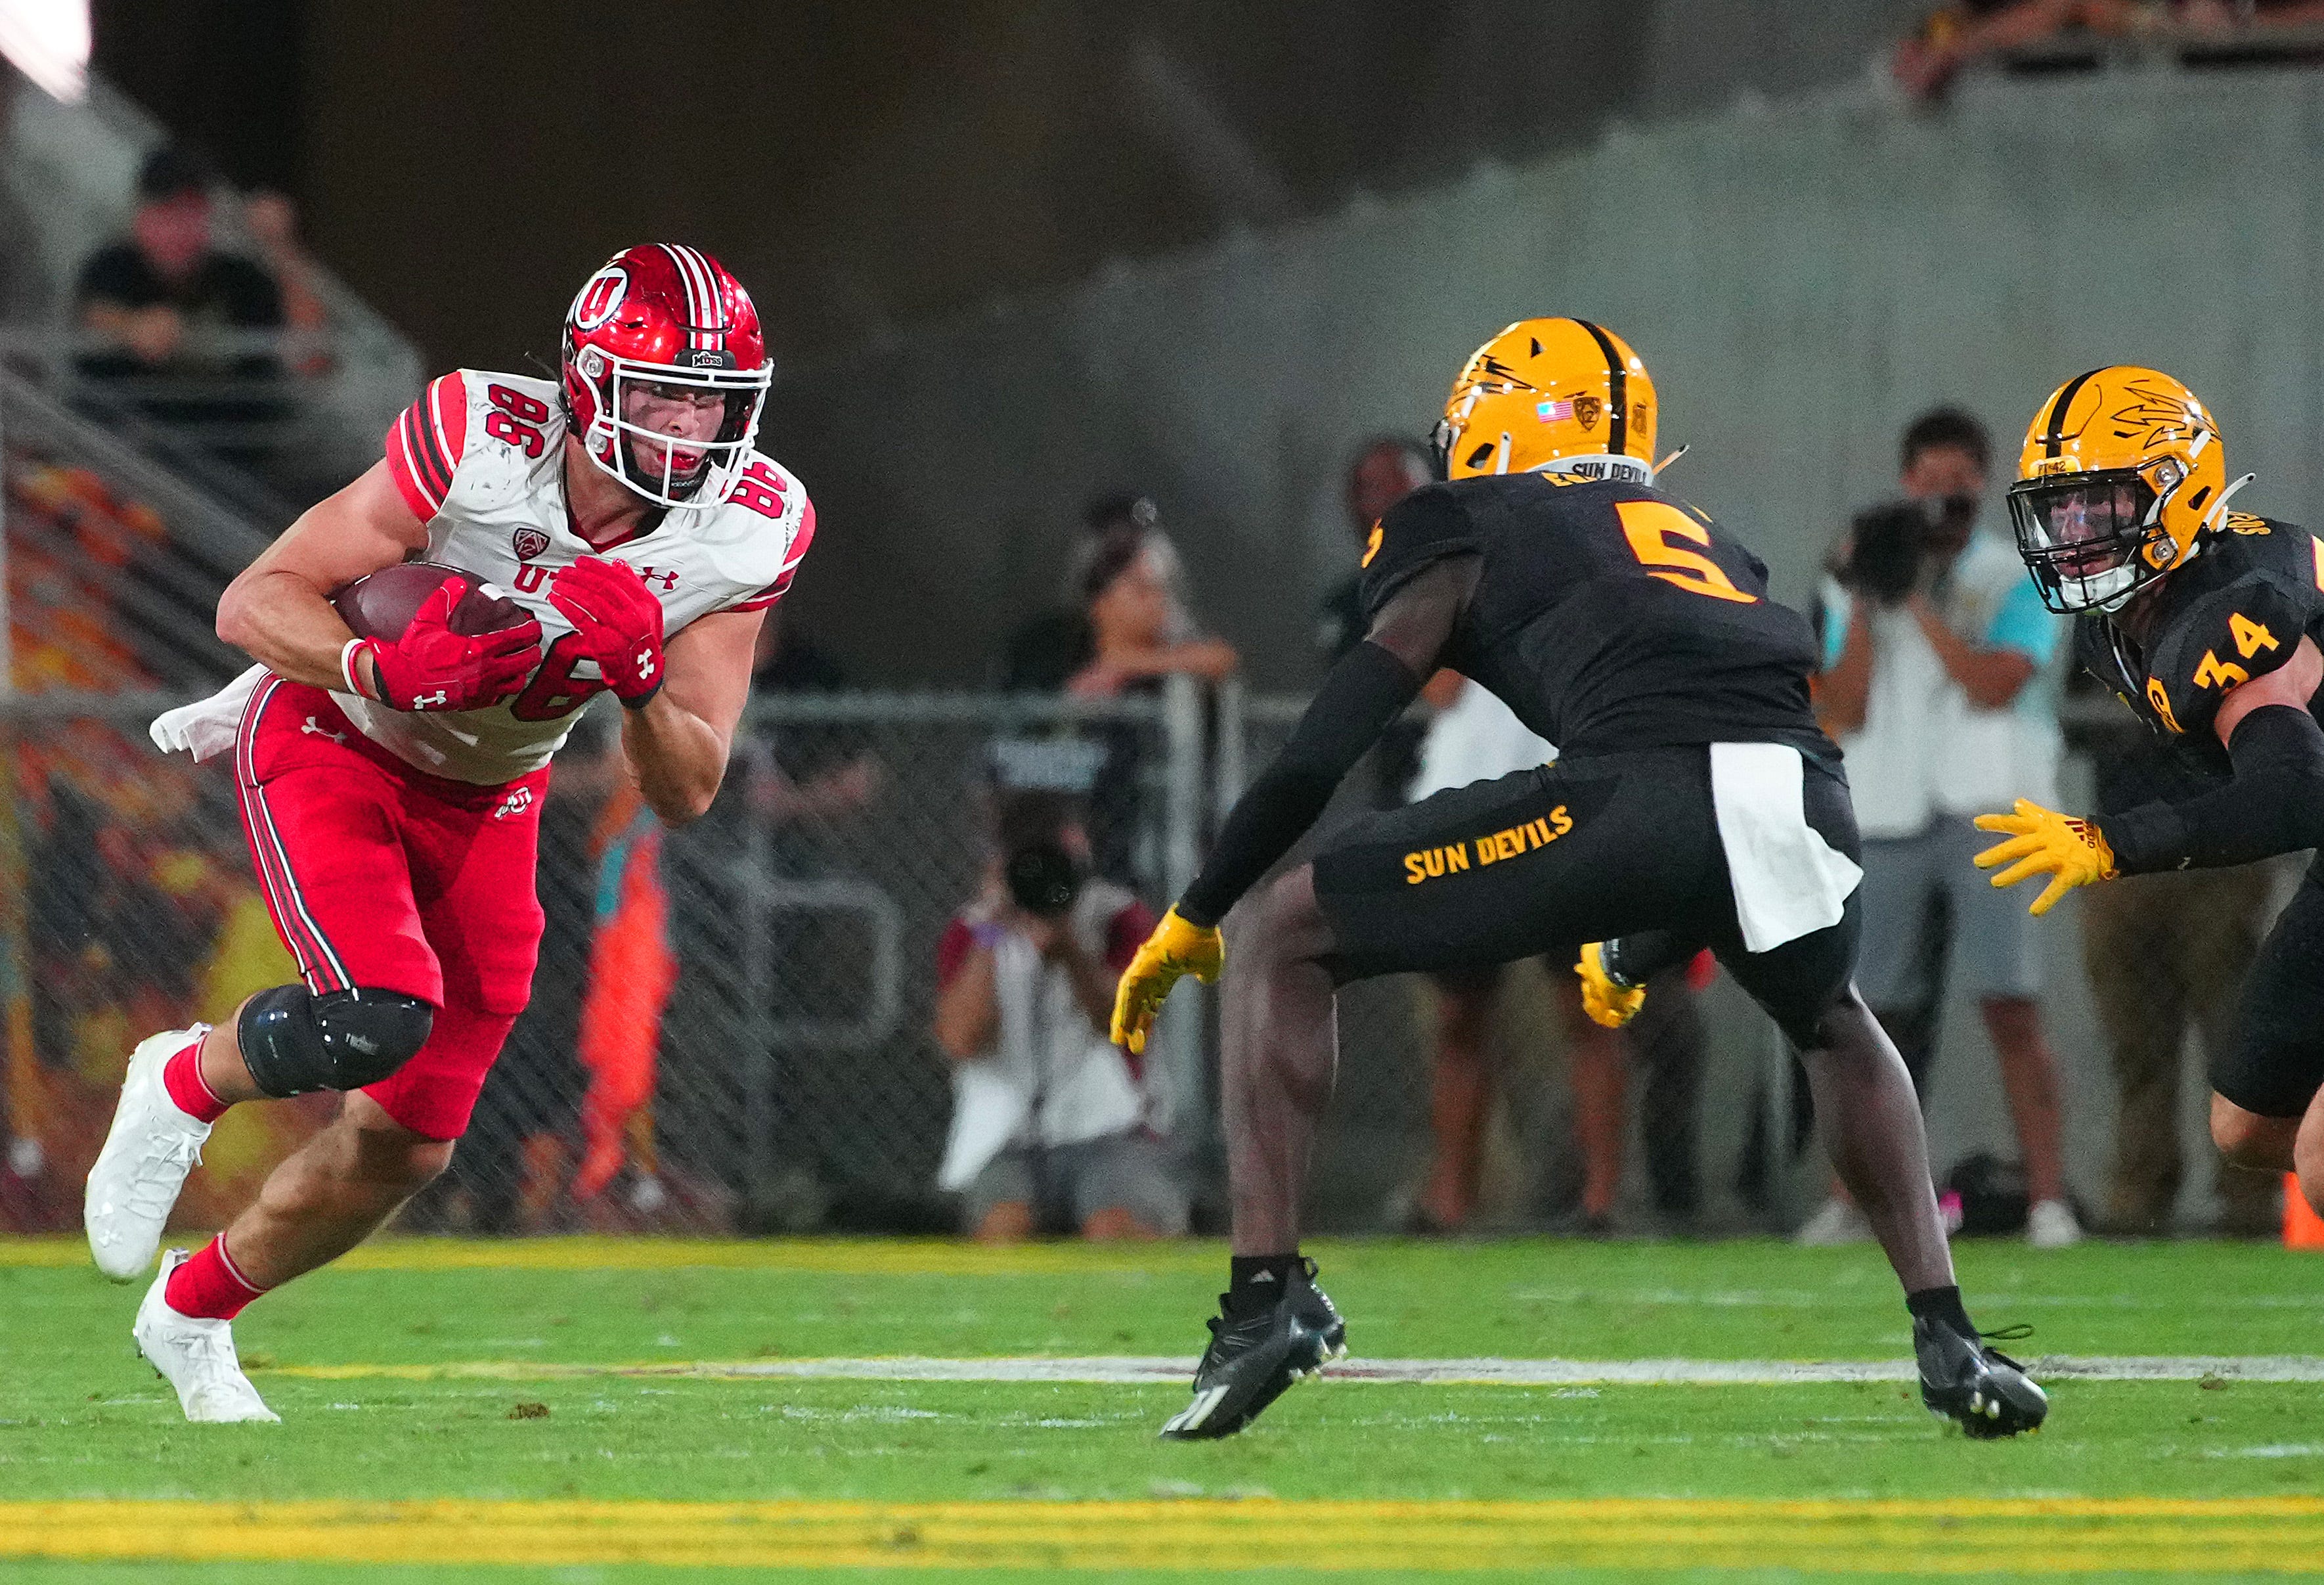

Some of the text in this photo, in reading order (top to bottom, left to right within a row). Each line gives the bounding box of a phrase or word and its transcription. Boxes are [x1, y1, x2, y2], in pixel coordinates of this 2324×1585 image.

[580, 277, 625, 323] U
[485, 383, 549, 459] 86
[718, 462, 787, 519] 86
[1613, 498, 1764, 605] 5
[2193, 611, 2280, 696] 34
[1404, 805, 1573, 884] SUN DEVILS
